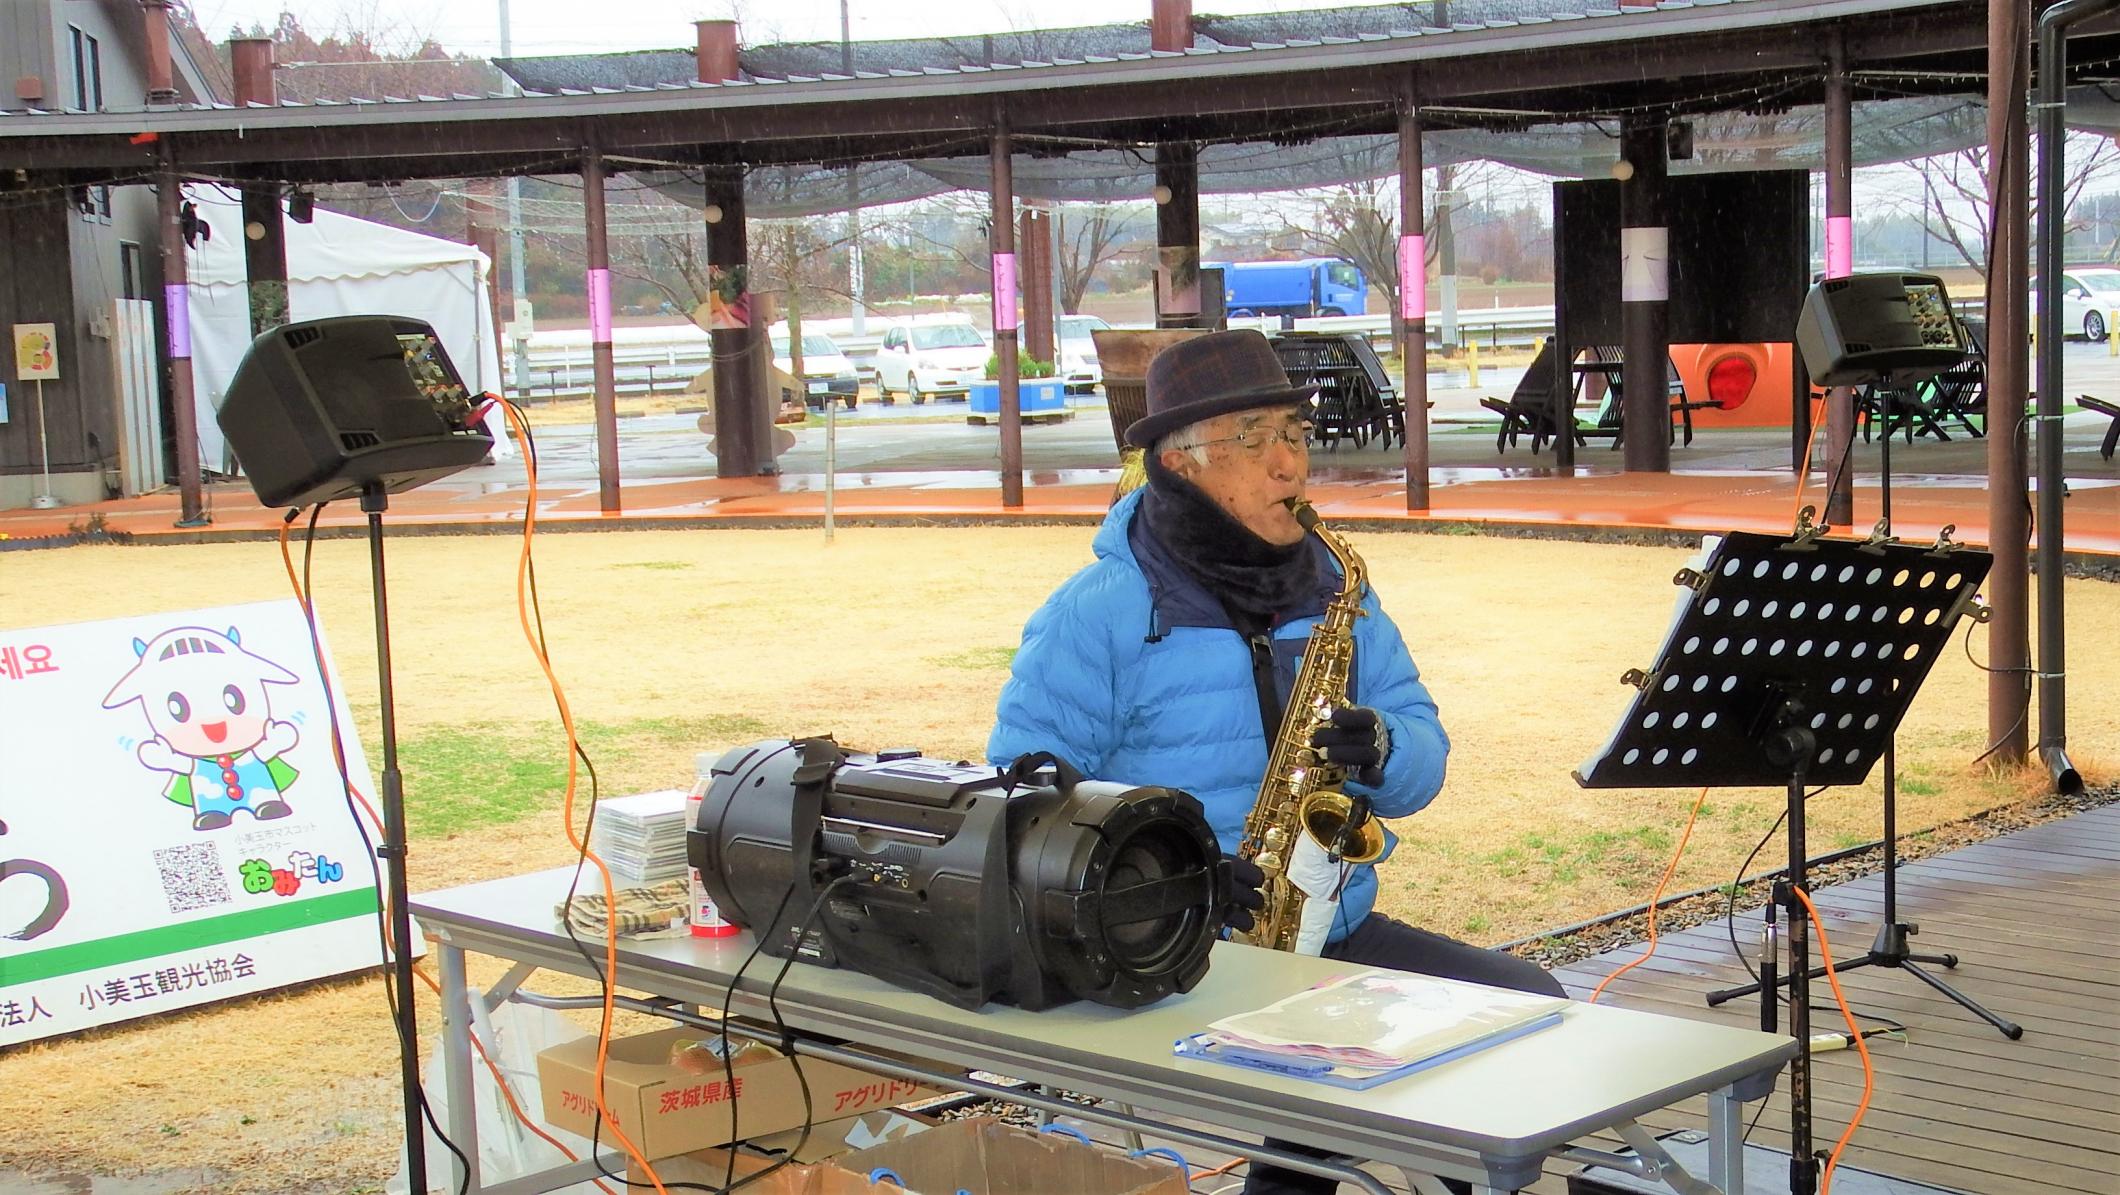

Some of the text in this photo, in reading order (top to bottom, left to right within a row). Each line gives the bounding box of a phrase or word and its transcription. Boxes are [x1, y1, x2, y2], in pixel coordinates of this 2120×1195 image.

[239, 841, 293, 856] キャラクター
[239, 850, 344, 896] おみたん
[79, 953, 257, 1012] 小美玉観光協会
[659, 1077, 743, 1114] 茨城県産
